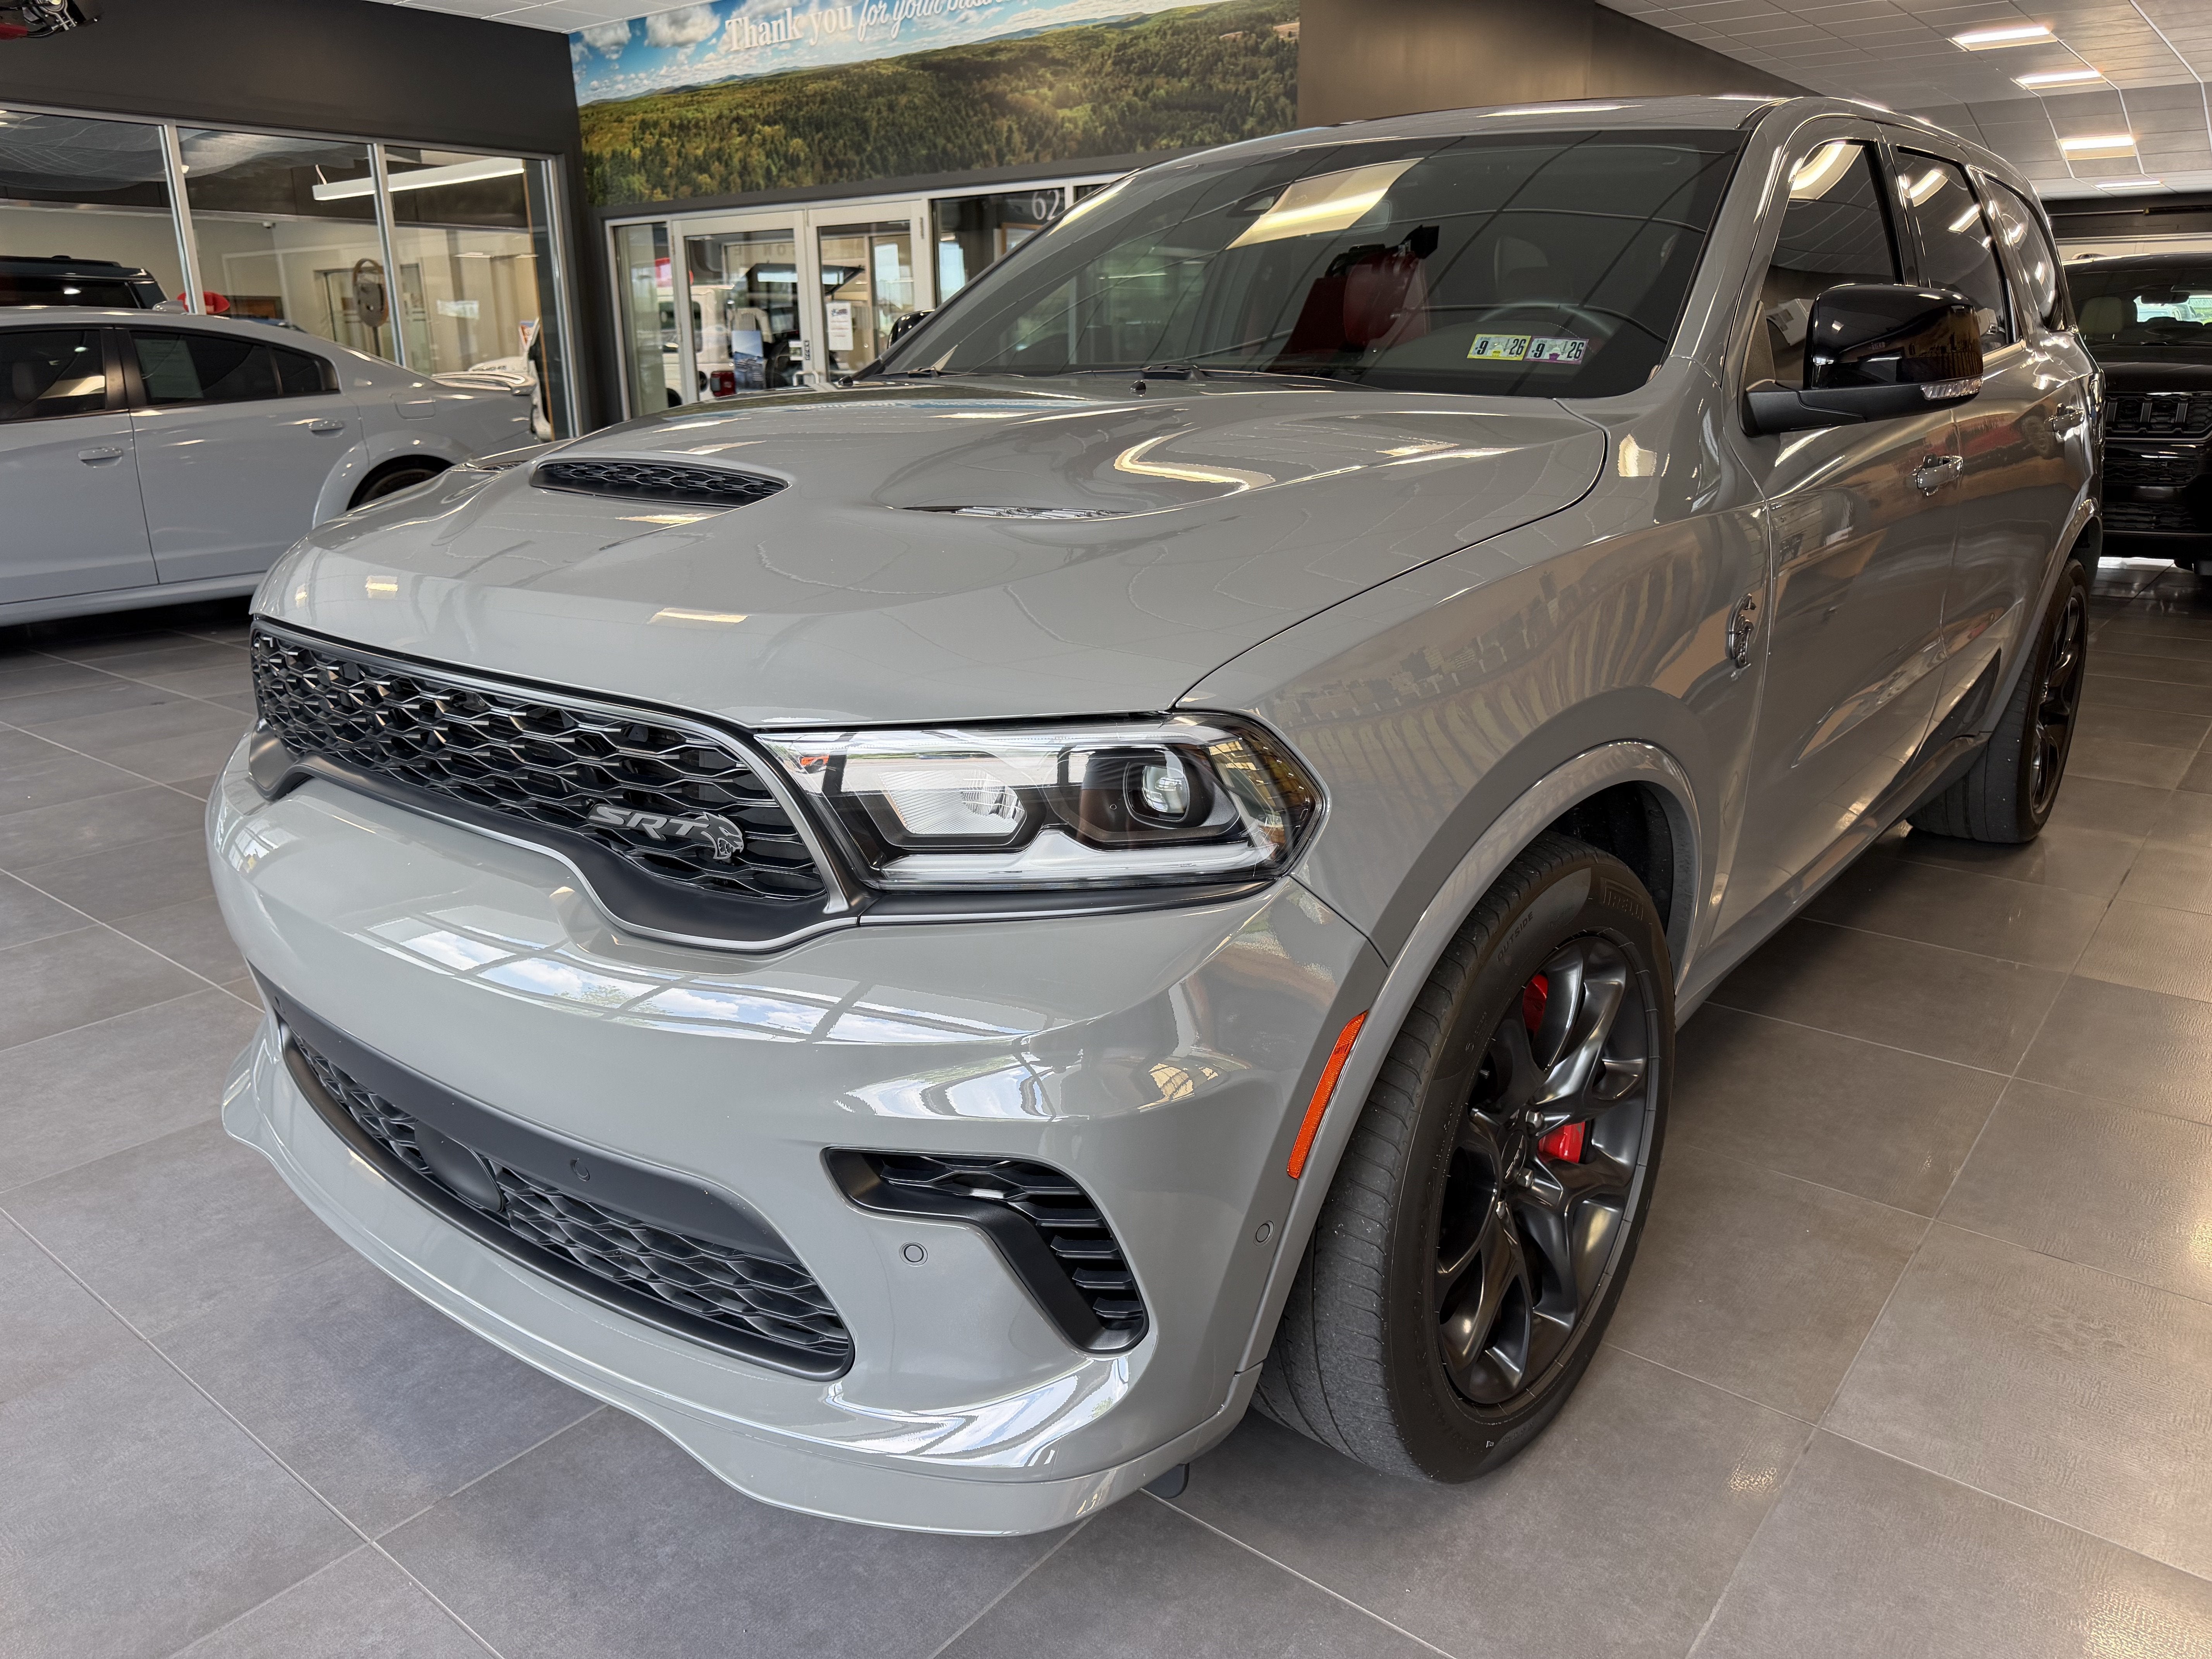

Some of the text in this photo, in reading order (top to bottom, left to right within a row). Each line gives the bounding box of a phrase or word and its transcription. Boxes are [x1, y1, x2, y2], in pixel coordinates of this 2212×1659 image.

[725, 7, 804, 51] Thank
[809, 5, 855, 46] you
[857, 0, 889, 41] for
[1031, 189, 1060, 221] 62
[1476, 340, 1489, 355] 9
[1508, 338, 1526, 356] 26
[1533, 343, 1545, 358] 9
[1567, 341, 1584, 359] 26
[589, 806, 709, 839] SRT
[1497, 911, 1534, 962] OUTSIDE
